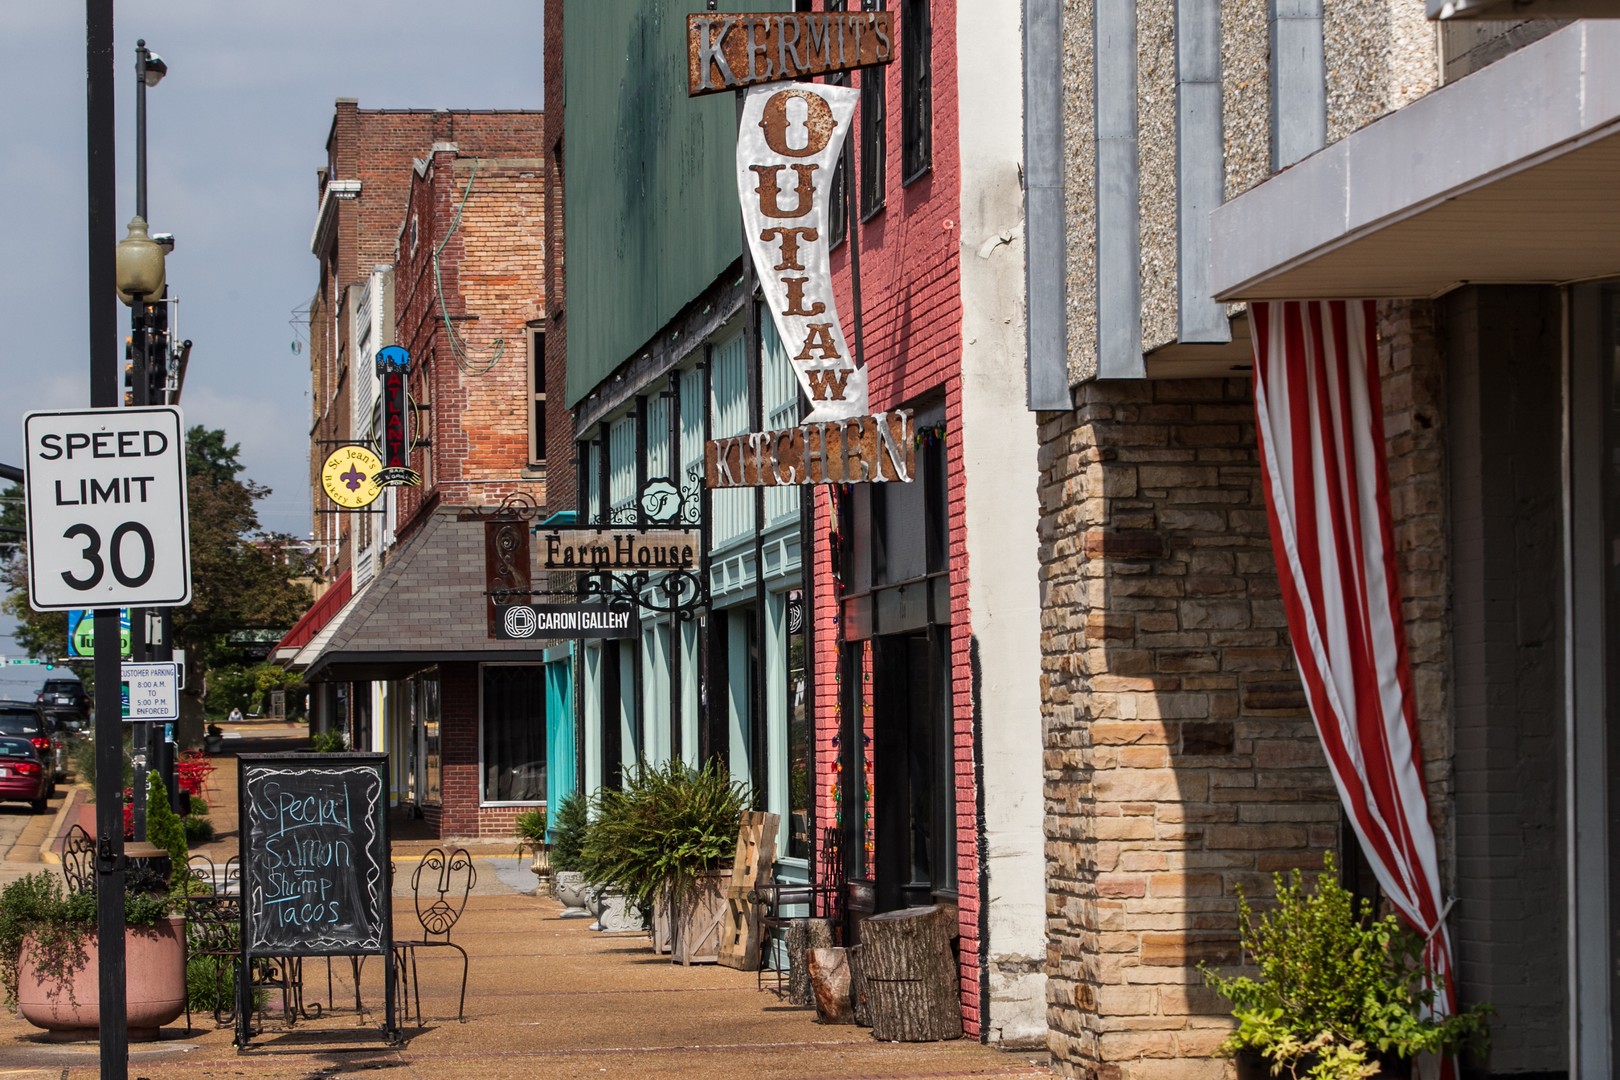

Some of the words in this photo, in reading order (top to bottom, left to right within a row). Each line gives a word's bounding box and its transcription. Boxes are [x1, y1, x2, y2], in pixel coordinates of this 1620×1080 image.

[691, 15, 891, 91] KERMIT'S
[748, 88, 855, 402] OUTLAW
[387, 373, 403, 467] ATLANTA
[39, 430, 168, 460] SPEED
[328, 459, 342, 470] St.
[346, 449, 376, 470] Jean's
[713, 408, 914, 487] KITCHEN
[55, 476, 155, 506] LIMIT
[324, 475, 349, 505] Bakery
[60, 521, 155, 590] 30
[544, 533, 694, 569] FarmHouse
[537, 611, 577, 630] CARON
[150, 668, 174, 677] PARKING
[136, 707, 169, 715] ENFORCED
[257, 781, 352, 837] Special
[265, 872, 333, 900] Shrimp
[264, 895, 340, 928] Tacos
